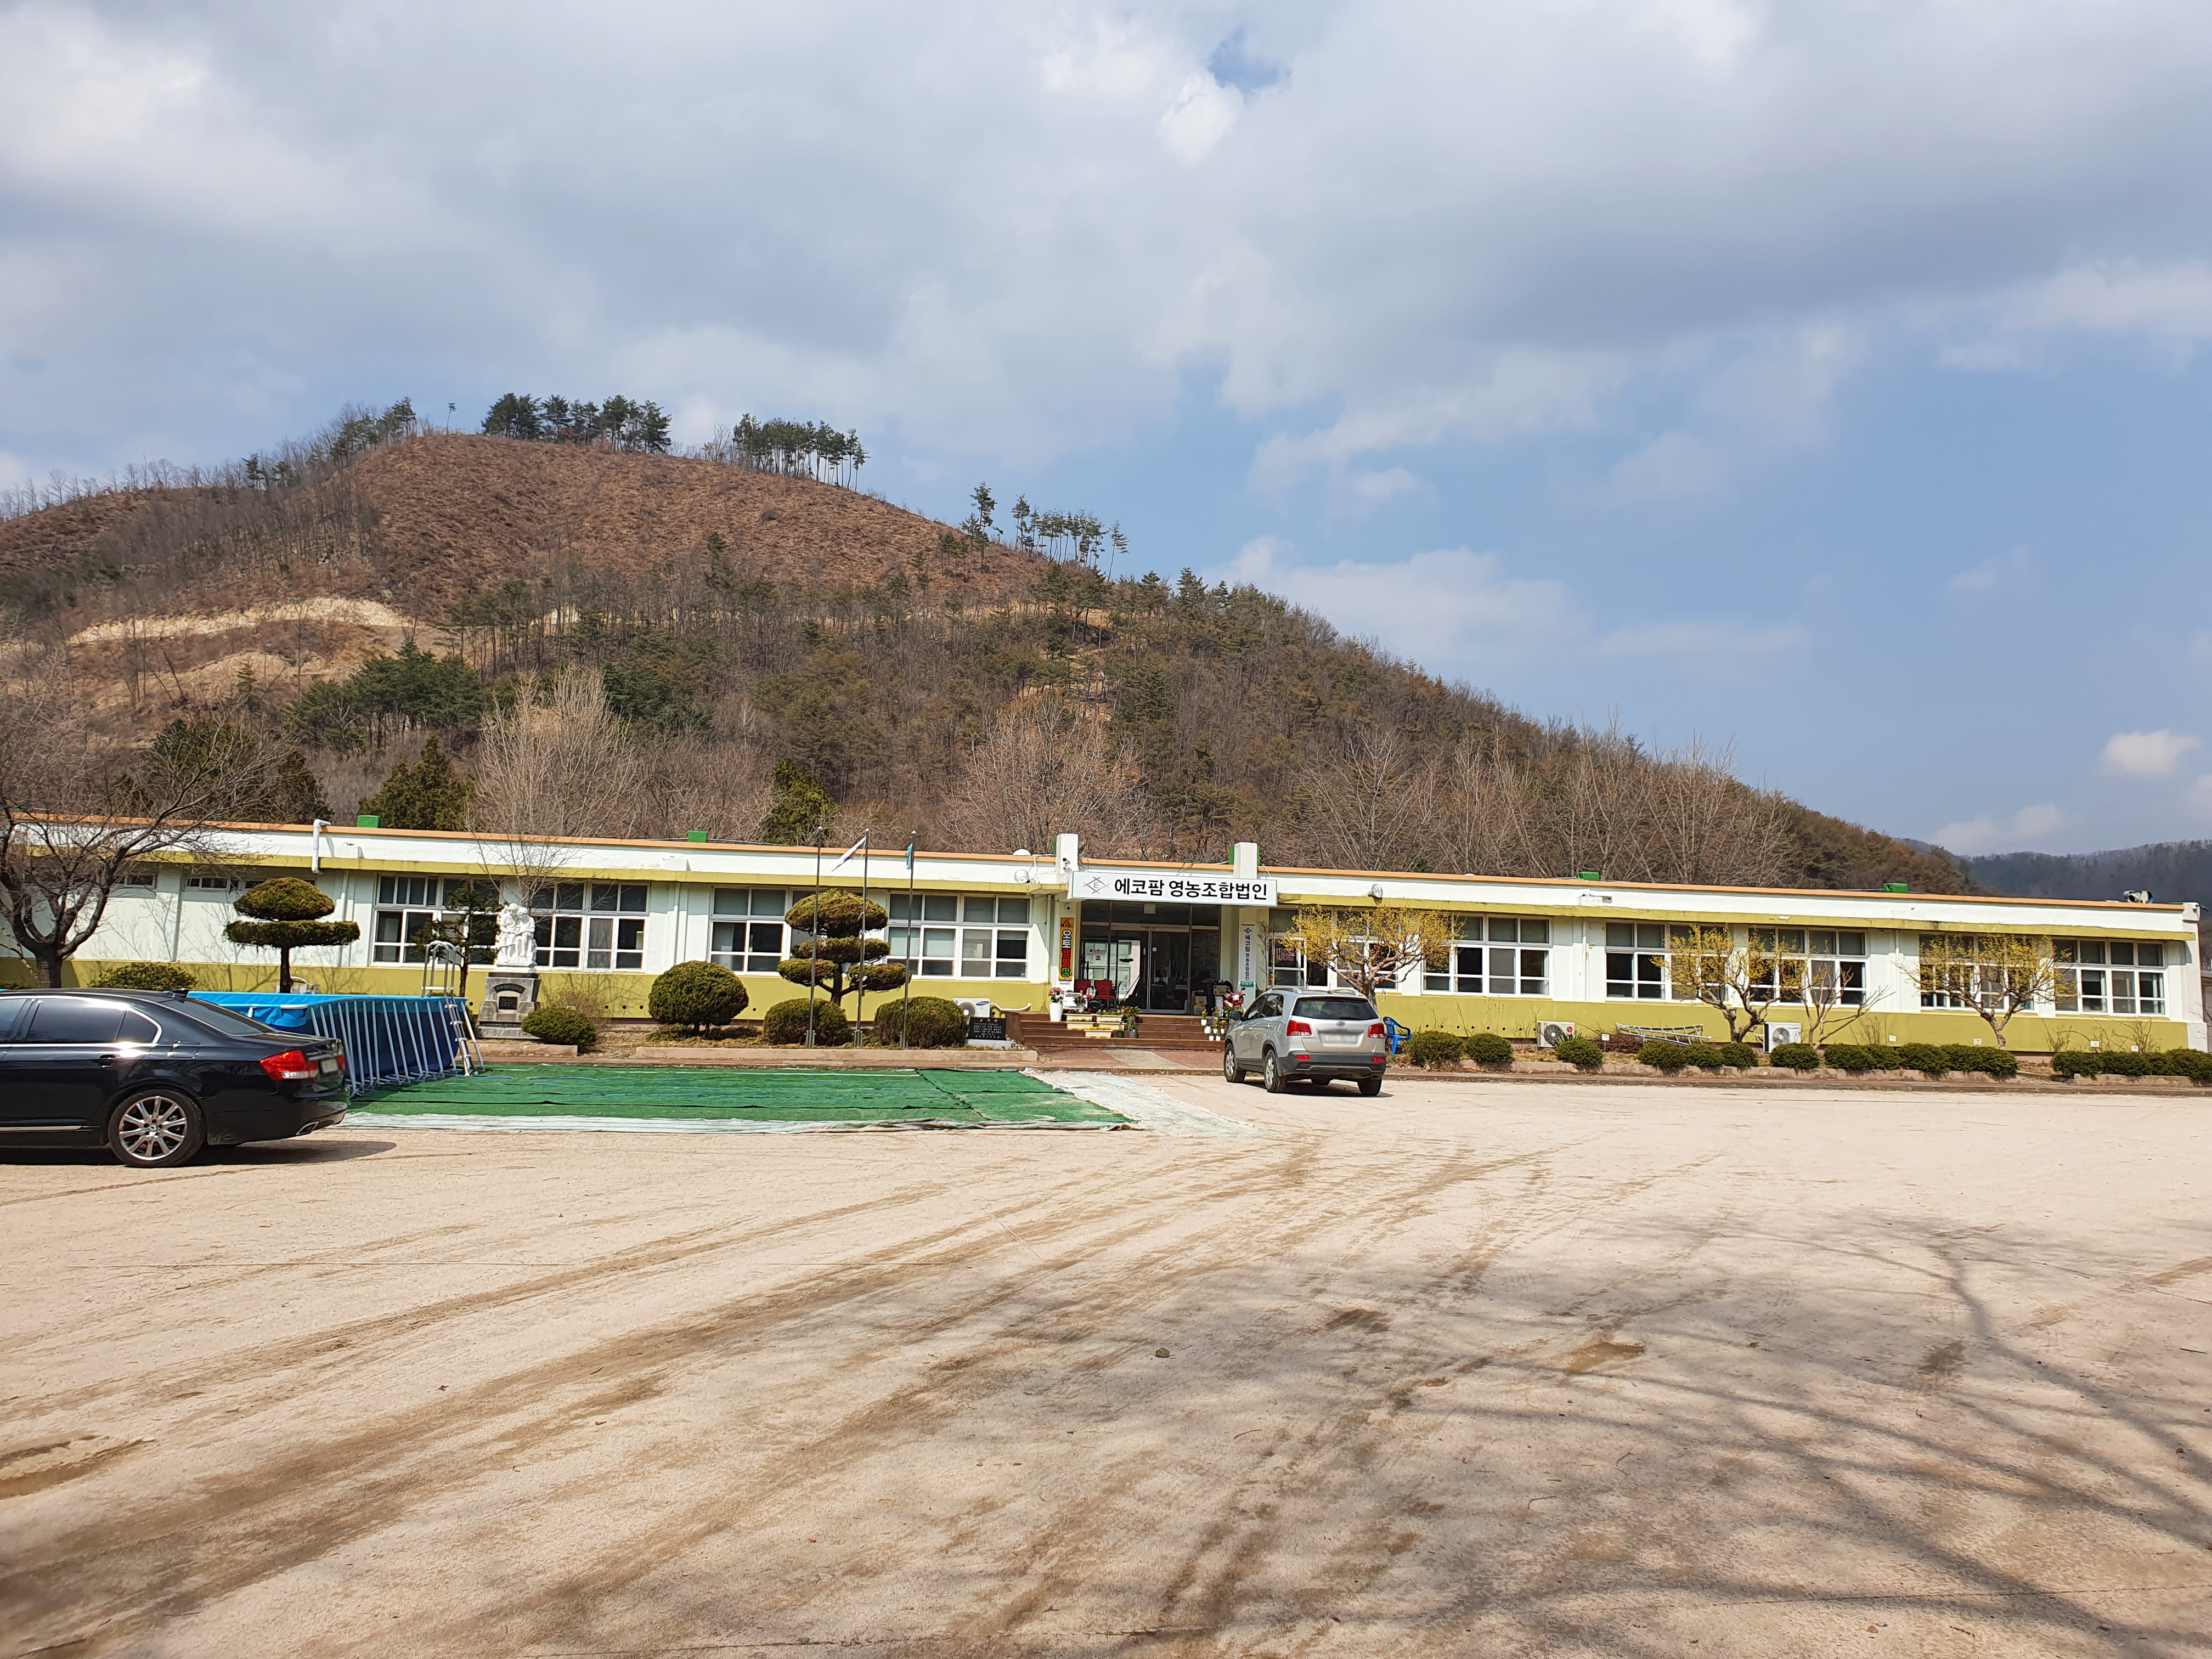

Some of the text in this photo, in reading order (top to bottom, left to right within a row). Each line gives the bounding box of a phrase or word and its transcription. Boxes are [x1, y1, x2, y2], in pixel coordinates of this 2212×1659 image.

[1114, 878, 1267, 900] 에코팜 영농조합법인
[1062, 929, 1072, 977] 오토캠핑장
